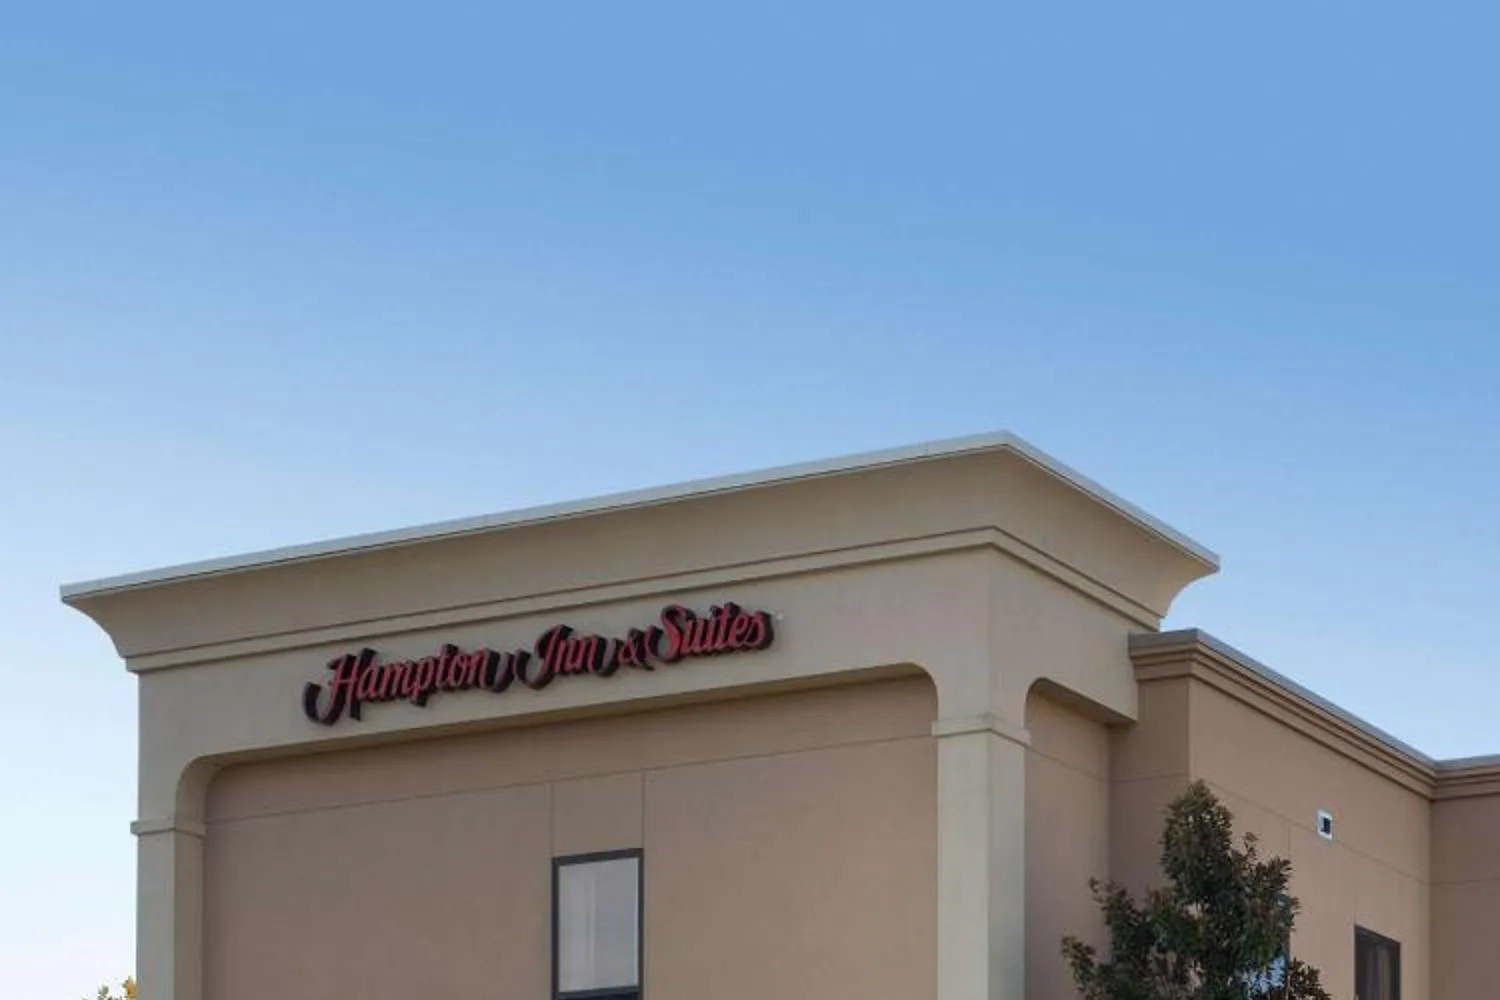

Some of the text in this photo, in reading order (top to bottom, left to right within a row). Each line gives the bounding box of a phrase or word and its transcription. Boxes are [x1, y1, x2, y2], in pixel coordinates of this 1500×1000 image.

[303, 602, 775, 726] Hampton Inn & Suites
